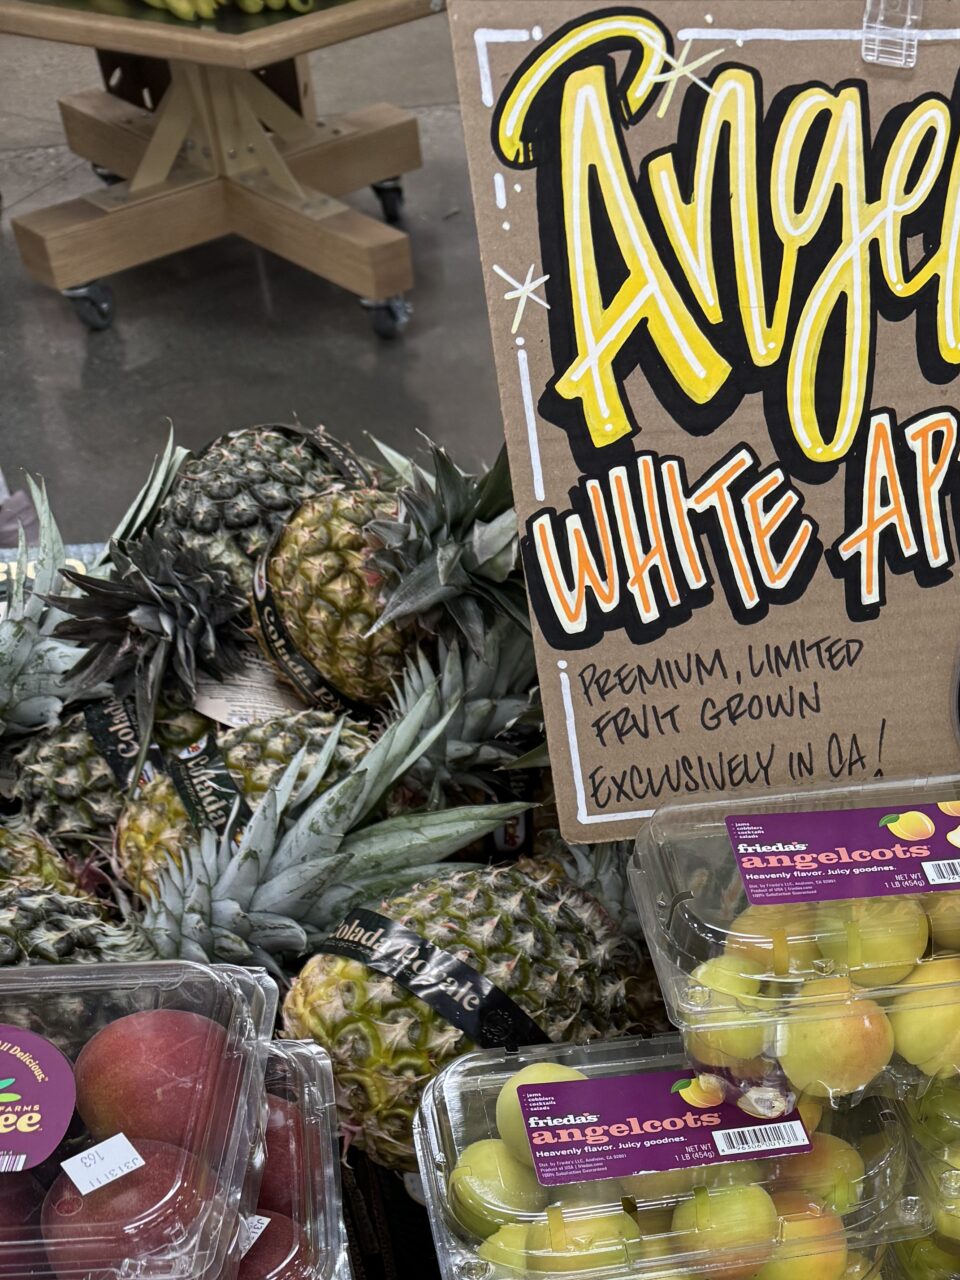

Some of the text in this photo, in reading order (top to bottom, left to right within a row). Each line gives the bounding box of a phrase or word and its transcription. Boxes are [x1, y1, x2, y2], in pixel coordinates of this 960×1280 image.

[532, 448, 814, 637] WHITE
[578, 636, 864, 706] PREMIUM, LIMITED
[591, 681, 821, 747] FRUIT GROWN
[588, 743, 776, 809] EXCLUSIVELY
[789, 742, 814, 781] IN
[736, 841, 806, 854] frieda's
[740, 842, 930, 869] angelcots
[745, 871, 791, 880] Heavenly
[852, 865, 897, 873] goodnes.
[527, 1112, 598, 1128] frieda's
[531, 1110, 722, 1145] angelcots
[535, 1147, 582, 1157] Heavenly
[618, 1140, 641, 1148] Juicy
[643, 1135, 687, 1146] goodnes.
